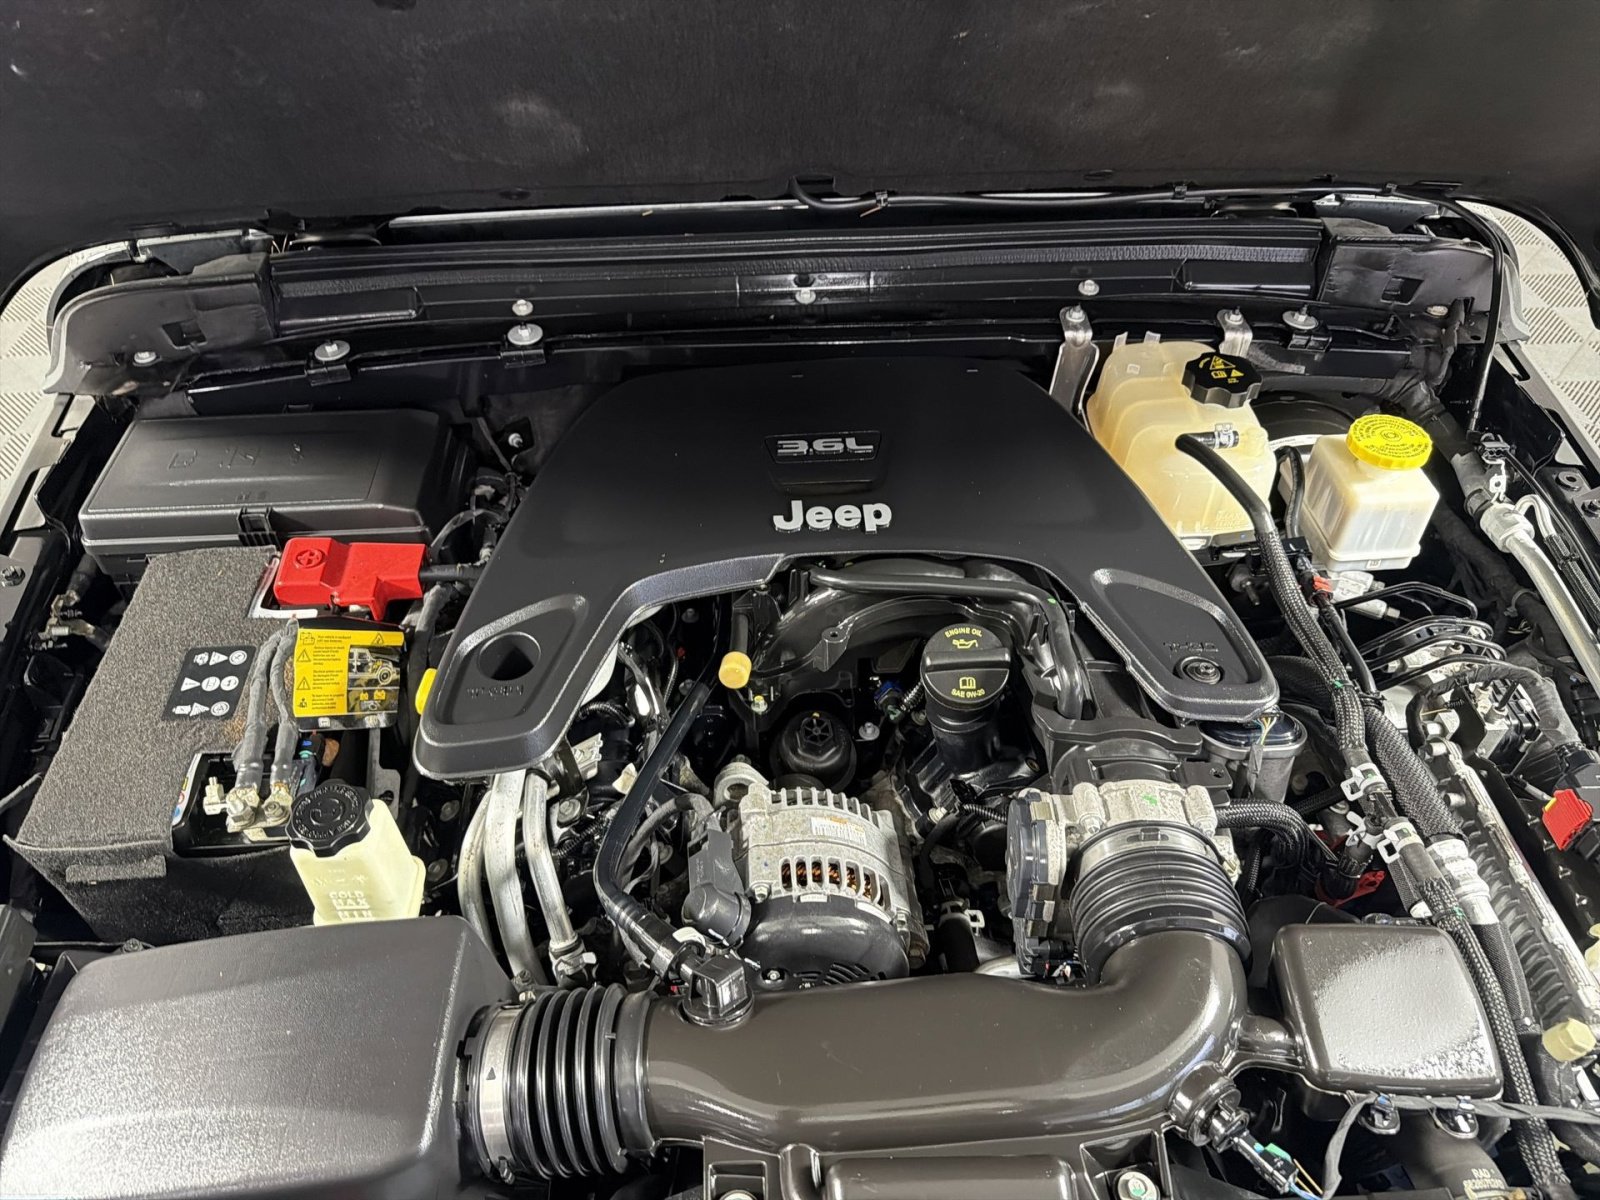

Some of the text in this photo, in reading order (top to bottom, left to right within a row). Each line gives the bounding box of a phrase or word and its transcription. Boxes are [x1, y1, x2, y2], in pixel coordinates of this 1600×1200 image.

[777, 437, 874, 456] 3.6L
[772, 500, 893, 534] Jeep
[944, 627, 983, 638] ENGINE OIL
[951, 688, 986, 698] SAE 0W-20
[329, 890, 364, 899] COLD
